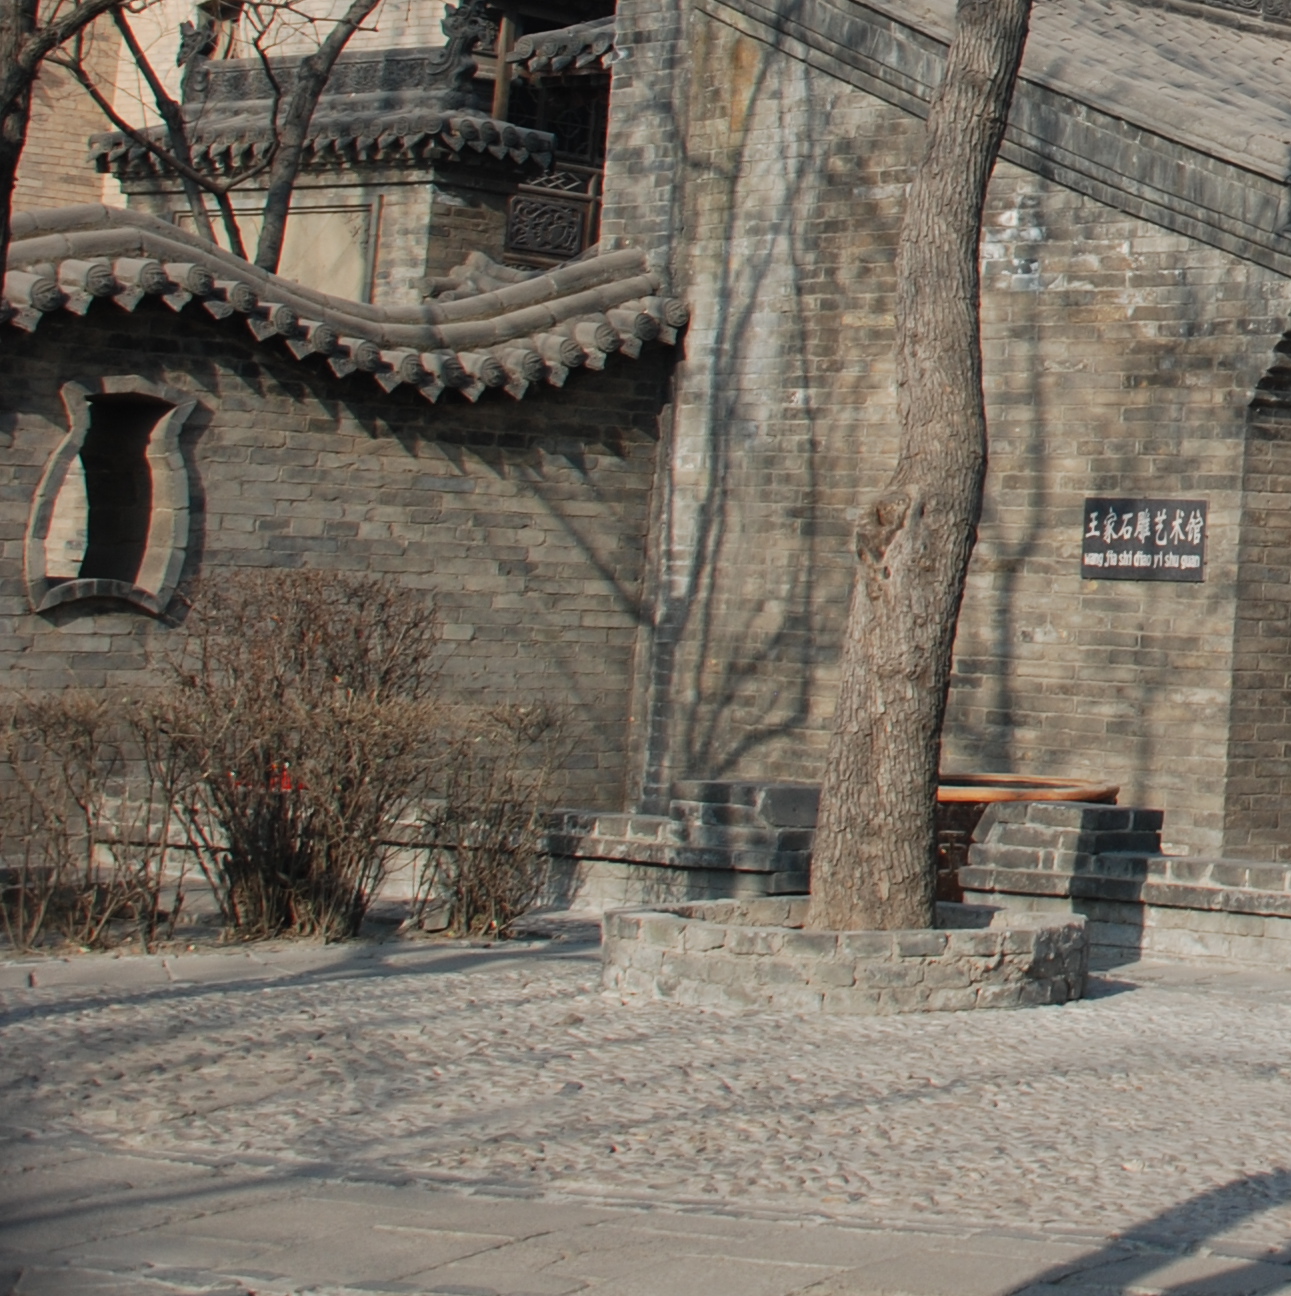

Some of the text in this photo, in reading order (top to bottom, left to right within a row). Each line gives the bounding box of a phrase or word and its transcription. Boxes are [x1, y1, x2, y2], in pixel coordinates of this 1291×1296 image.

[1085, 507, 1204, 546] 王家石雕艺术馆
[1084, 552, 1104, 567] wang
[1118, 550, 1133, 566] shi
[1153, 550, 1163, 569] yi
[1164, 551, 1179, 568] shu
[1180, 554, 1200, 570] guan
